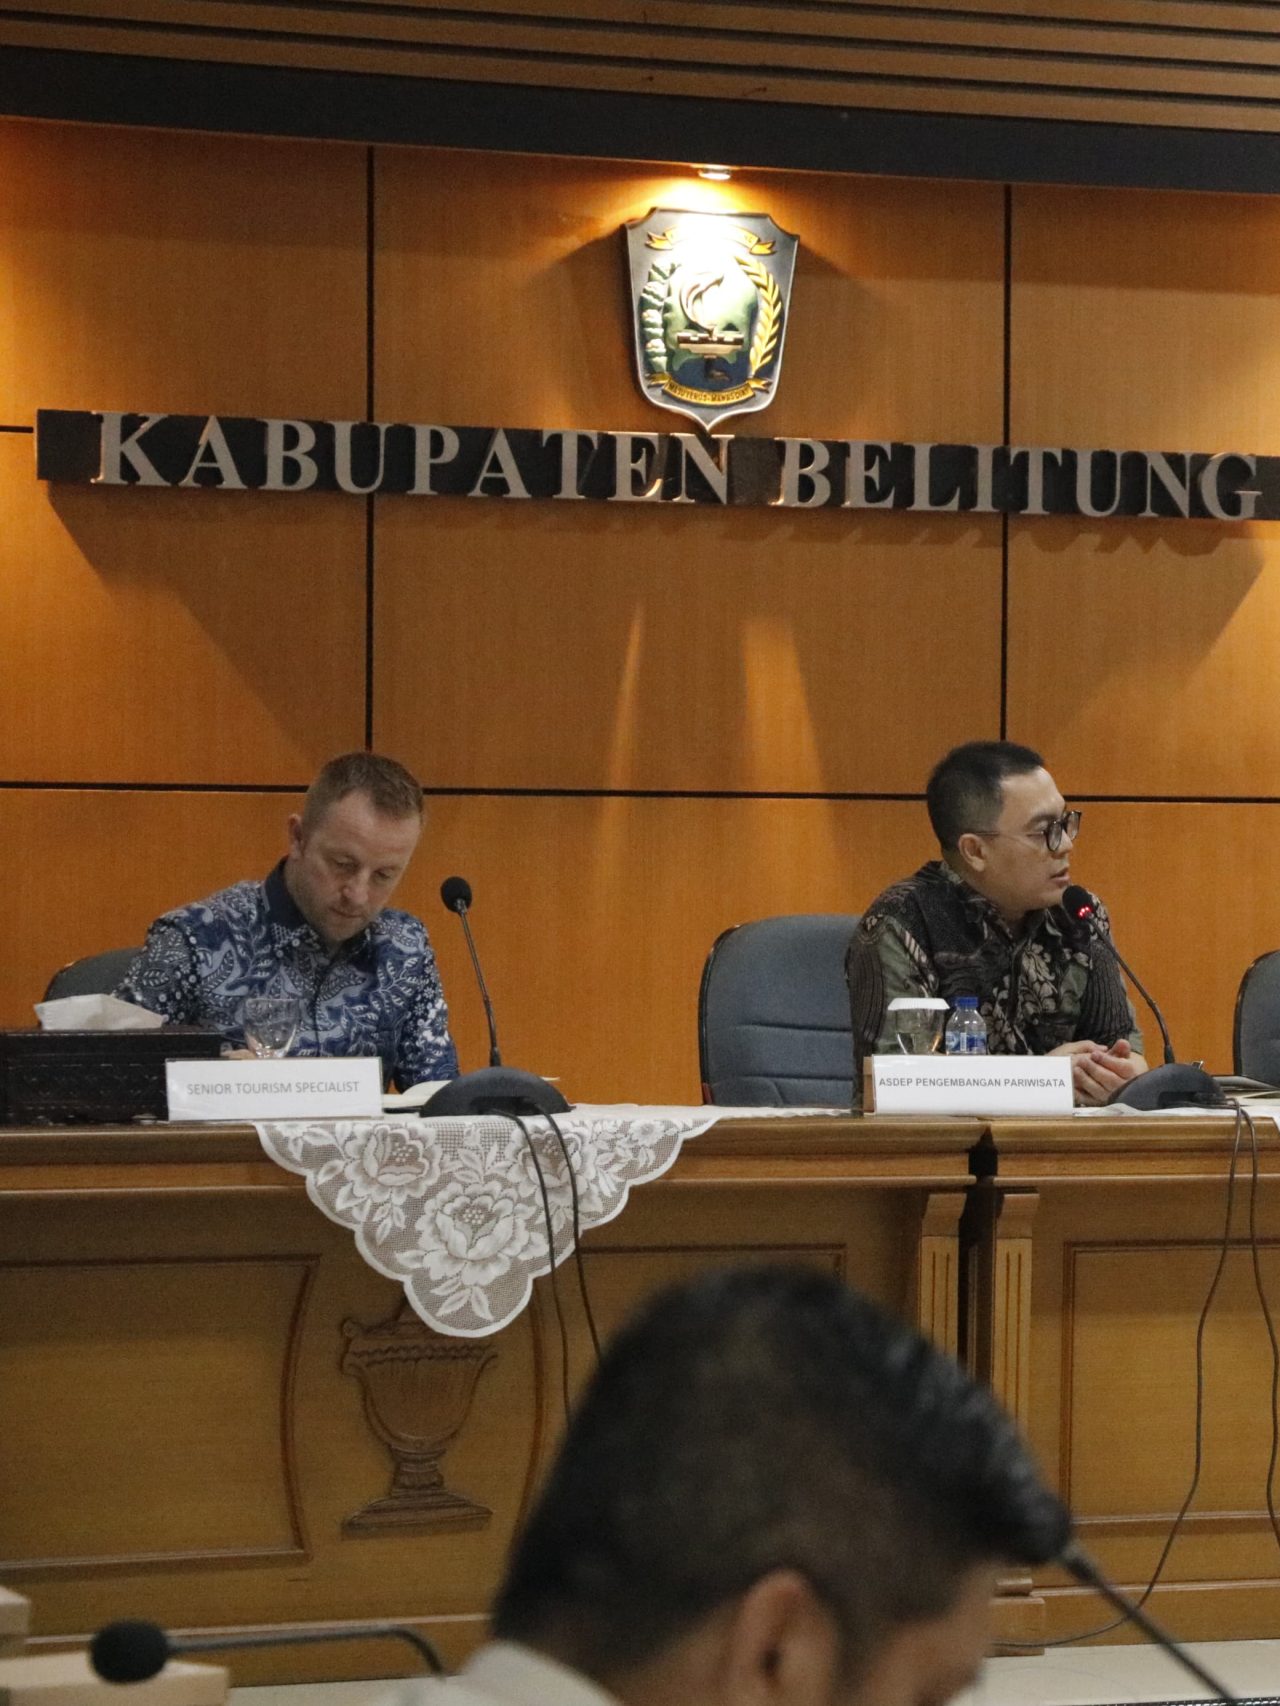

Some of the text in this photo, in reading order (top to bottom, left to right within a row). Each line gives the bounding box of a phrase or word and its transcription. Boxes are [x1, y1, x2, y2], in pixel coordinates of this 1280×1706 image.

[90, 410, 1263, 521] KABUPATEN BELITUNG
[186, 1081, 359, 1095] SENIOR TOURISM SPECIALIST
[879, 1077, 1066, 1088] ASDEP PENGEMBANGAN PARIWISATA
